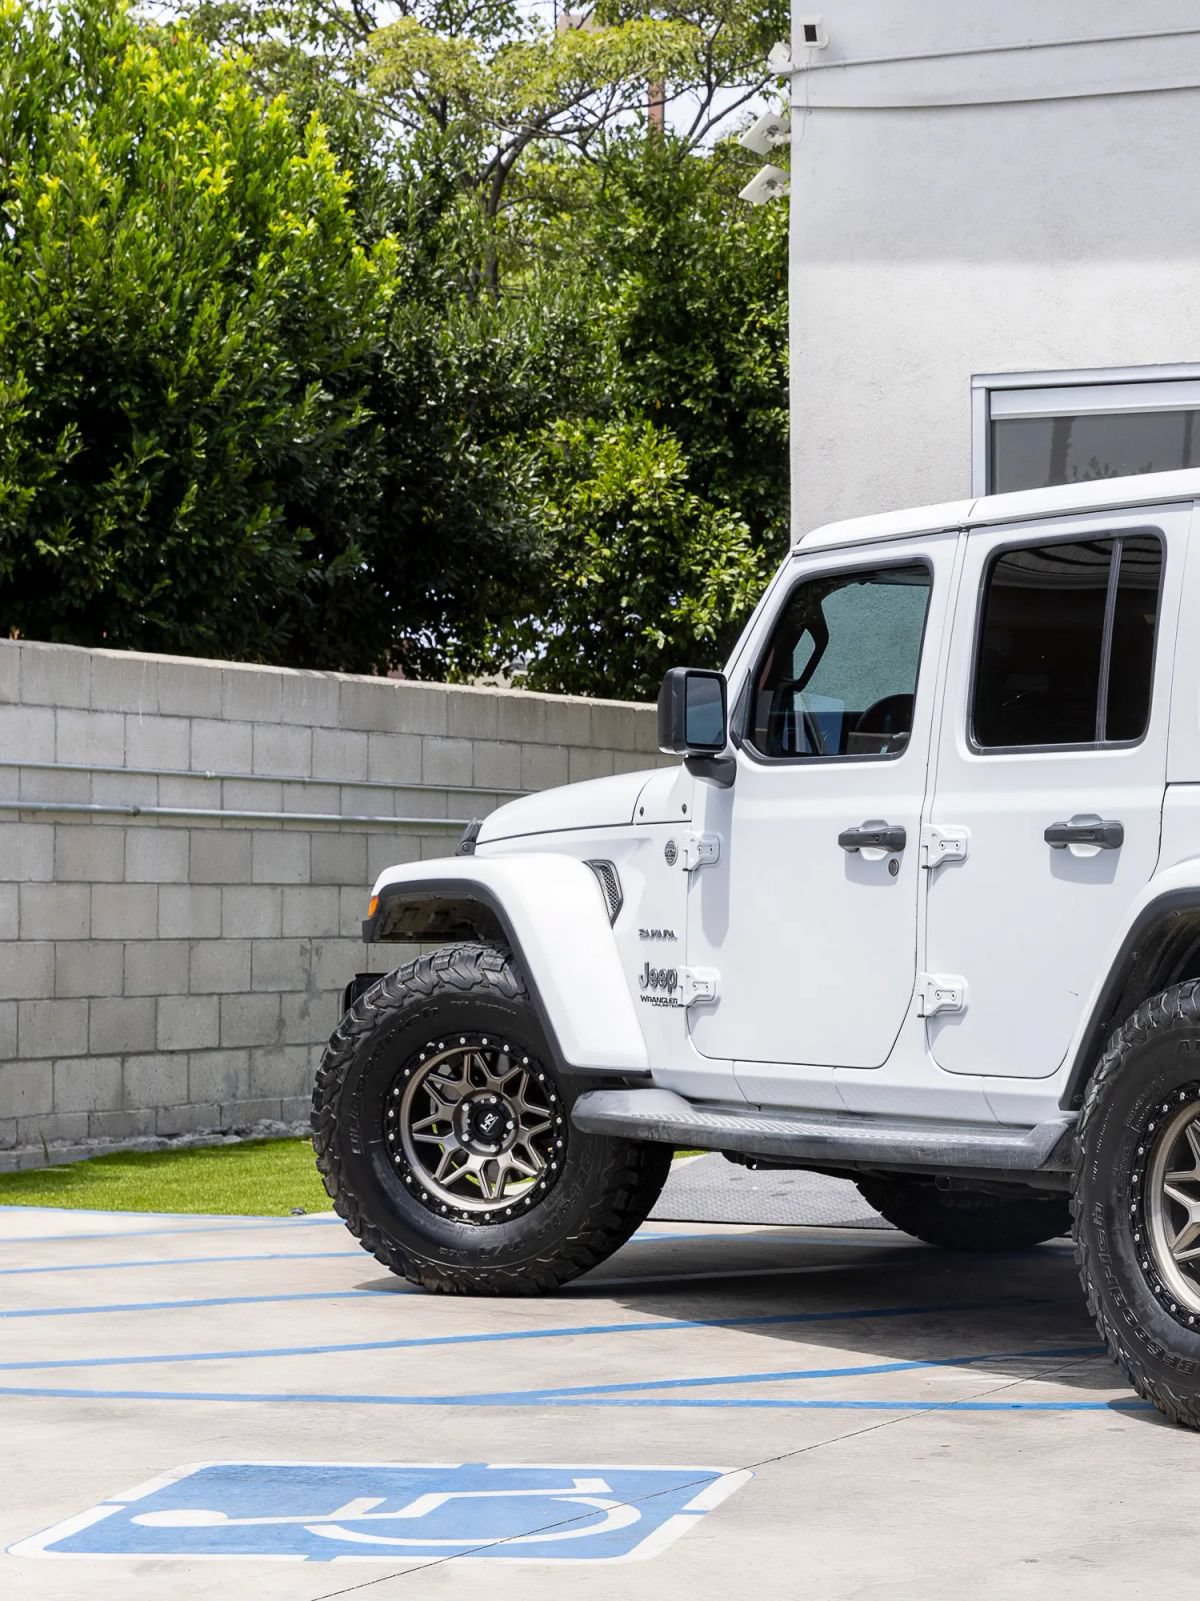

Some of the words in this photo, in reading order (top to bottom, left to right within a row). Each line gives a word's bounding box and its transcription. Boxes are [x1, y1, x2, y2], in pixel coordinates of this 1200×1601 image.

[638, 929, 677, 940] SAHARA
[639, 961, 678, 994] Jeep
[640, 995, 678, 1004] WRANGLER
